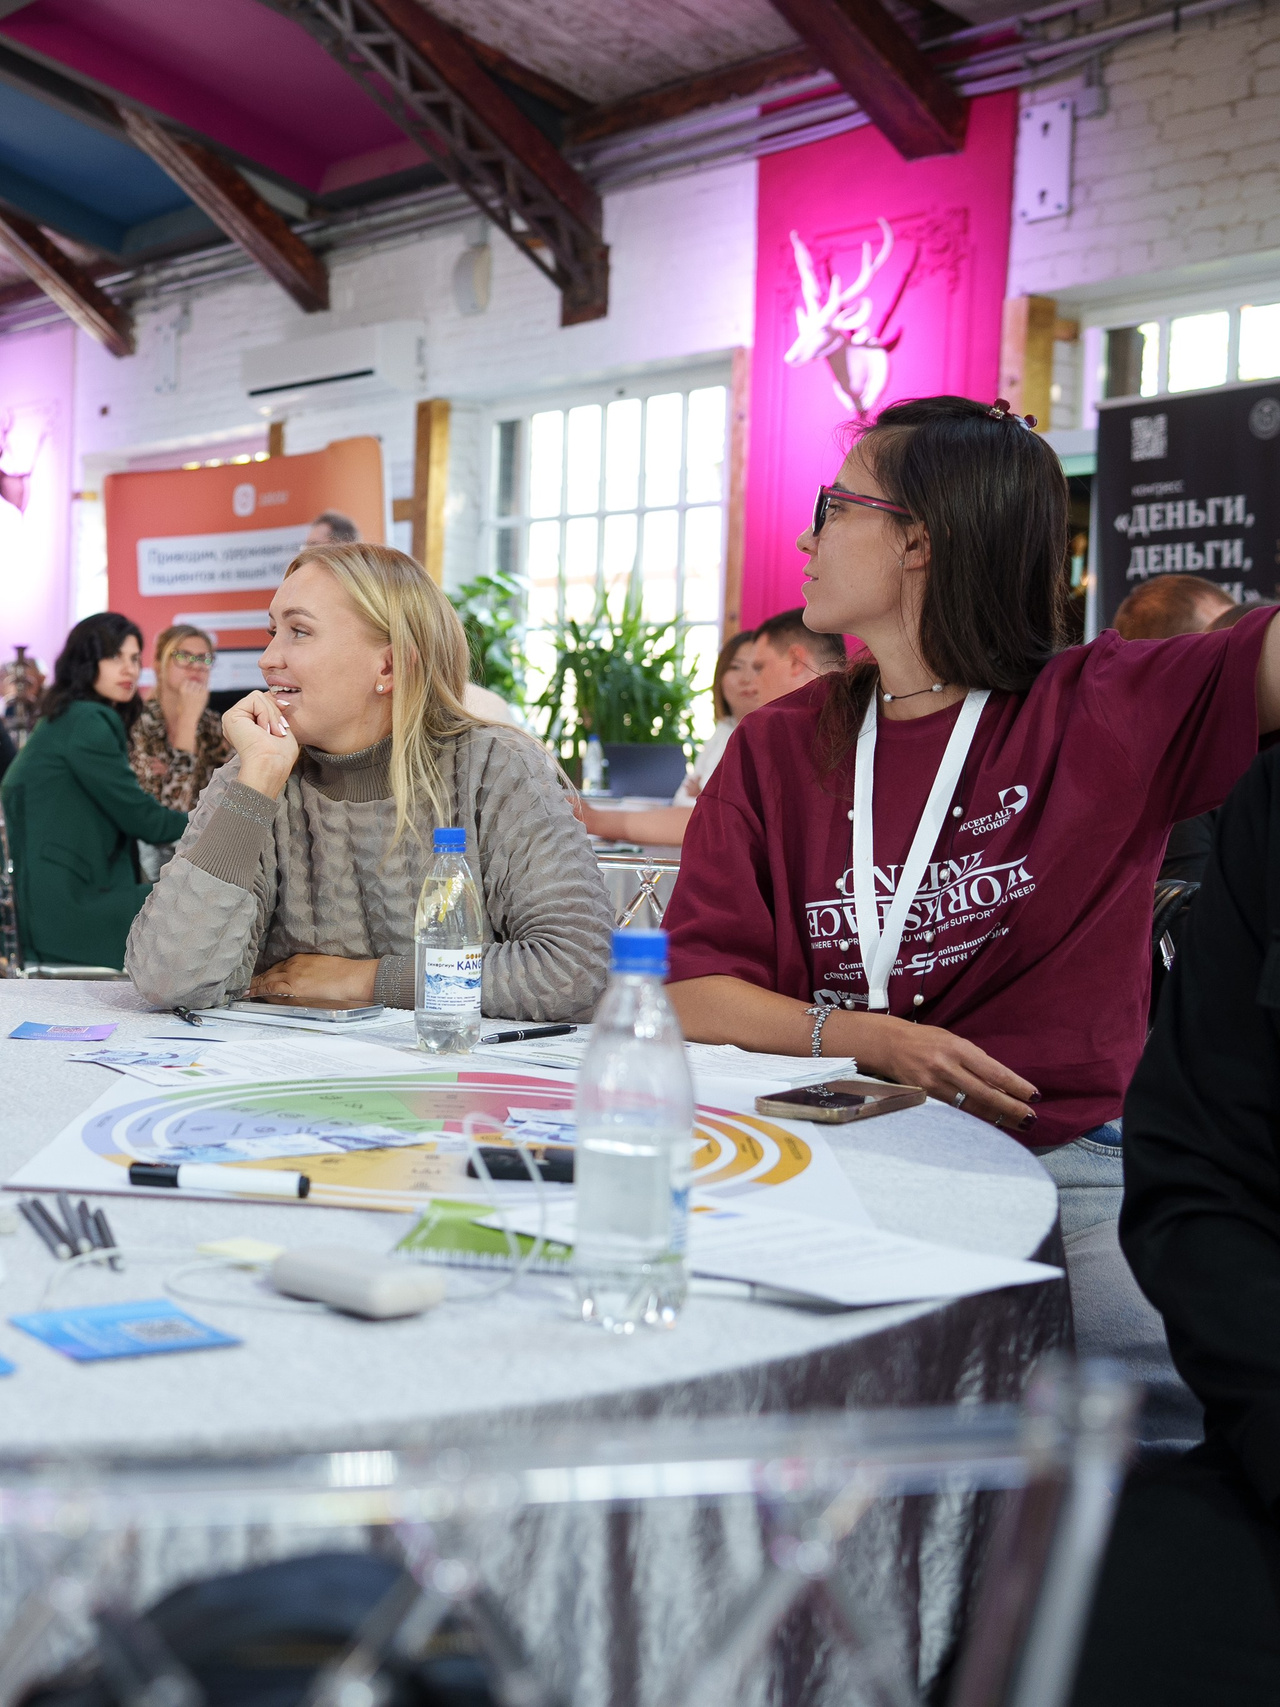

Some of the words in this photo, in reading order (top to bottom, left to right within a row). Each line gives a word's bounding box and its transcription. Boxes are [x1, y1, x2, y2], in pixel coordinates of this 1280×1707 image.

[1114, 495, 1255, 538] «ДЕНЬГИ,
[1126, 538, 1253, 581] ДЕНЬГИ,
[994, 809, 1011, 820] ALL
[937, 921, 950, 934] THE
[950, 908, 996, 927] SUPPORT
[1010, 883, 1036, 900] NEED
[456, 959, 482, 971] KANG
